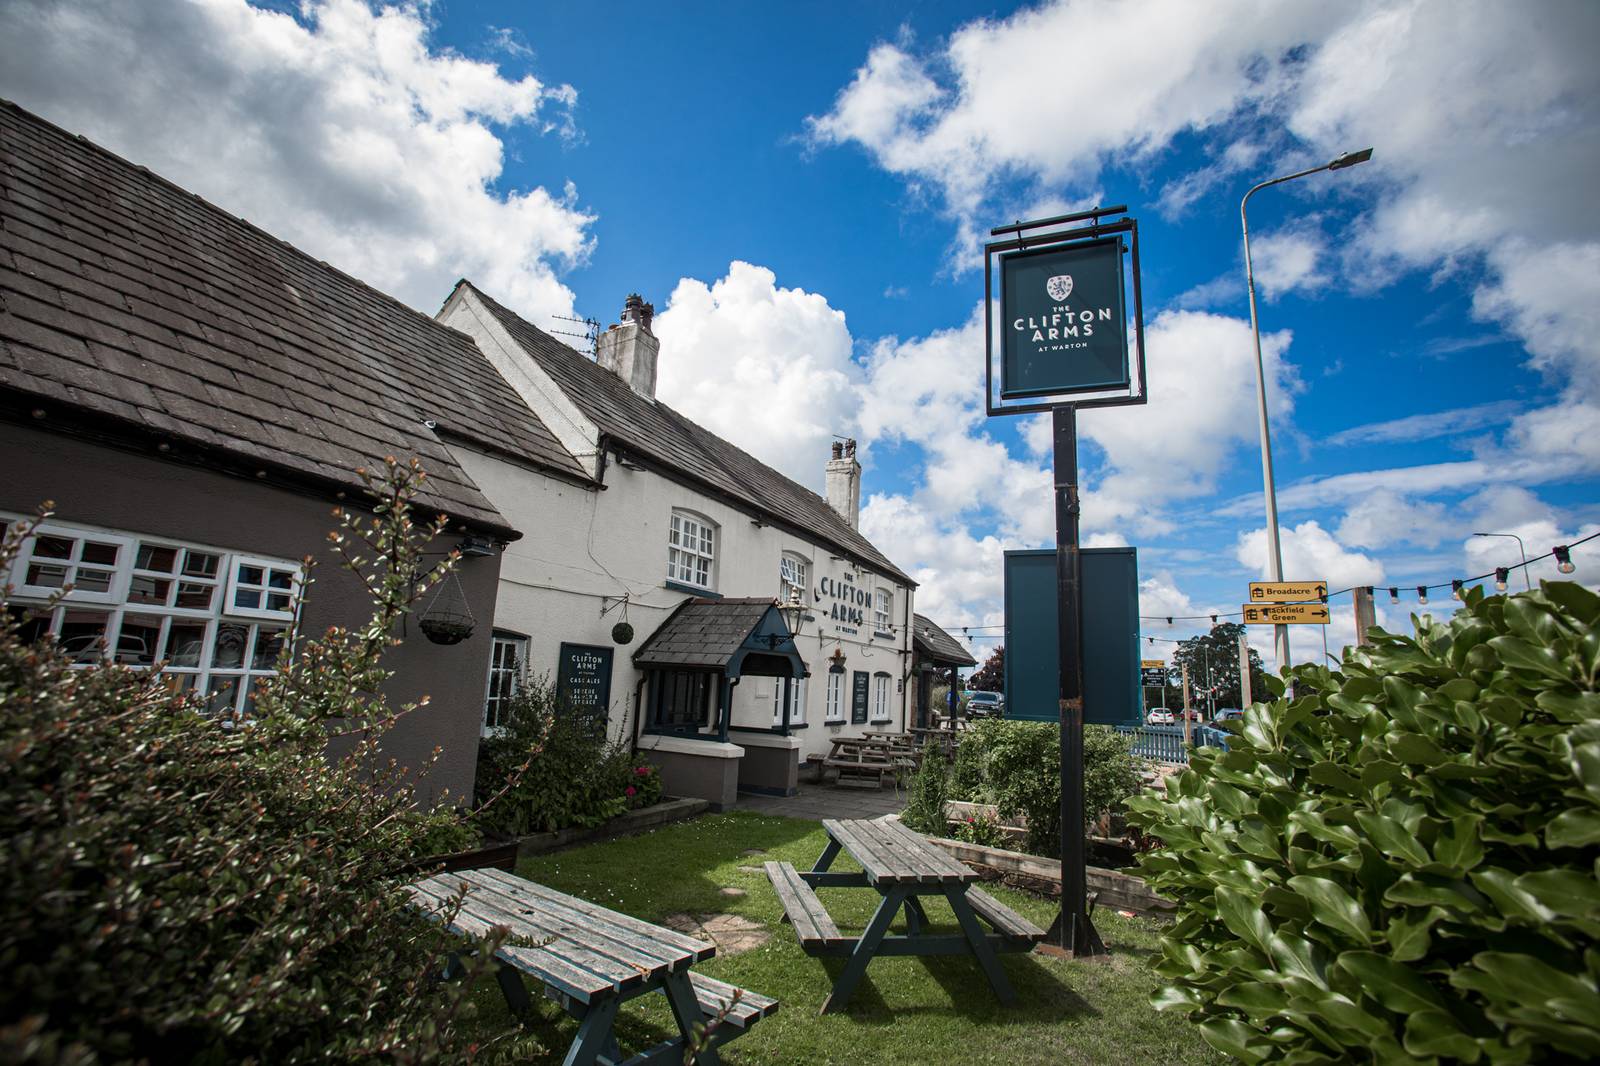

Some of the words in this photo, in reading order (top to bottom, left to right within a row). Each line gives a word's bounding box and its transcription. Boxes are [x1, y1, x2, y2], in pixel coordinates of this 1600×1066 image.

[1014, 308, 1111, 331] CLIFTON
[1032, 323, 1094, 342] ARMS
[1051, 342, 1088, 351] WARTON
[844, 572, 853, 582] THE
[821, 577, 872, 608] CLIFTON
[831, 602, 863, 625] ARMS
[571, 655, 603, 664] CLIFTON
[576, 662, 597, 670] ARMS
